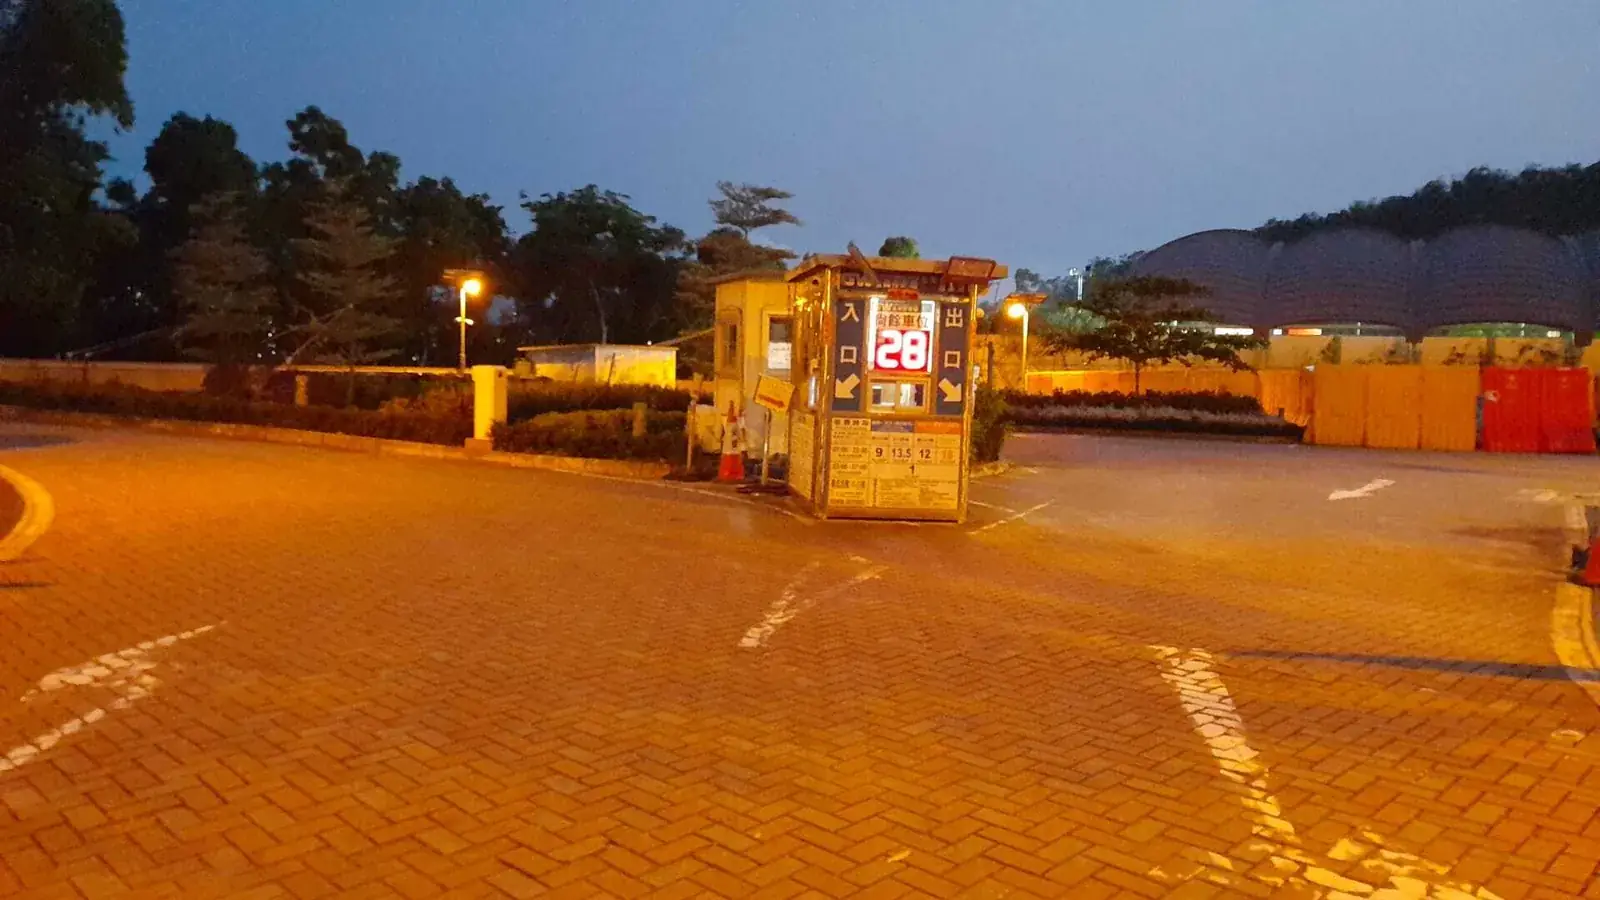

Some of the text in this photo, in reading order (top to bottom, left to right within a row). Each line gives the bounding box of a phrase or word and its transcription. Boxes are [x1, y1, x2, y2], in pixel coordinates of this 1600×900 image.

[840, 302, 860, 364] 入口
[944, 307, 964, 369] 出口
[876, 329, 927, 370] 28
[875, 447, 883, 458] 9
[891, 447, 912, 459] 13.5
[918, 448, 931, 460] 12
[909, 464, 915, 475] 1
